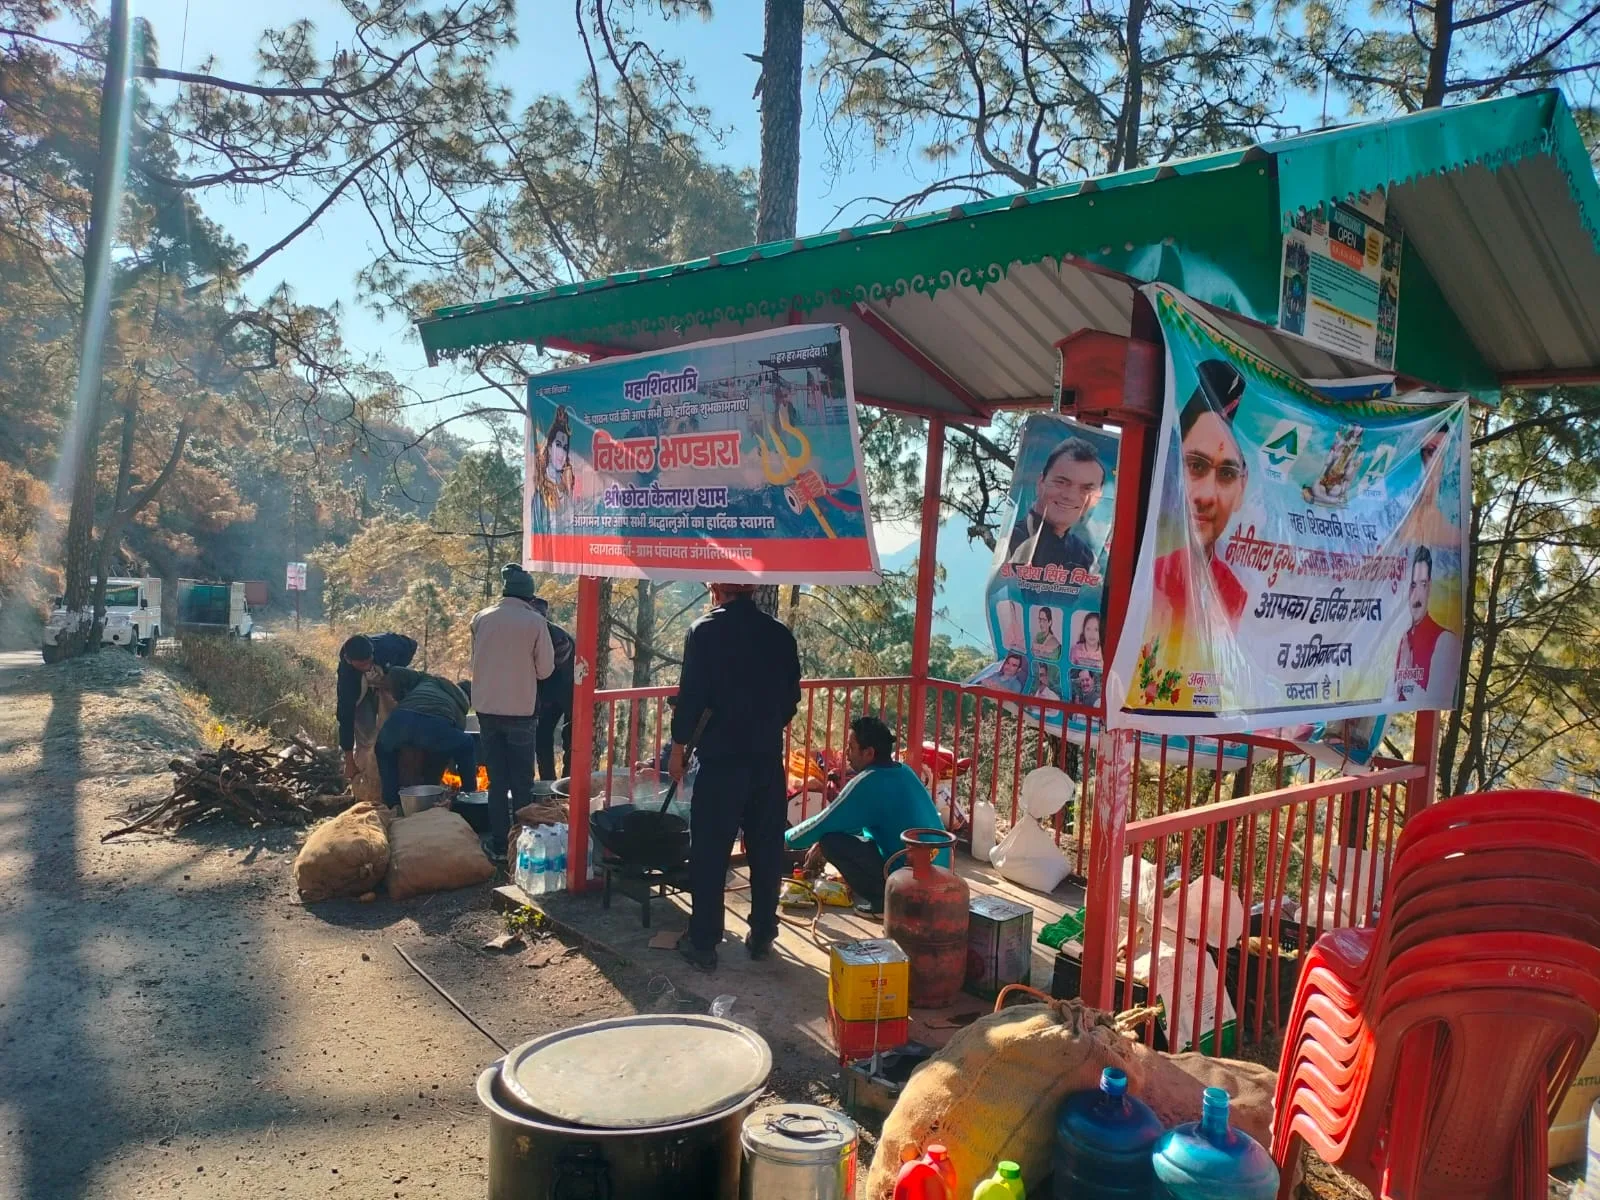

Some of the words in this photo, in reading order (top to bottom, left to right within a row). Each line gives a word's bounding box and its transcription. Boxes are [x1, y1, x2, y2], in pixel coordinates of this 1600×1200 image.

[1337, 226, 1357, 249] OPEN
[776, 352, 786, 364] हर
[786, 350, 795, 362] हर
[796, 345, 820, 360] महादेव
[624, 366, 699, 402] महाशिवरात्रि
[609, 409, 620, 422] पर्व
[620, 408, 630, 422] की
[631, 409, 646, 421] आप
[648, 405, 662, 419] सभी
[663, 404, 673, 418] को
[674, 401, 699, 418] हार्दिक
[593, 430, 656, 473] विशाल
[658, 431, 741, 472] भण्डारा
[604, 483, 620, 508] श्री
[621, 484, 650, 507] छोटा
[650, 482, 695, 508] कैलाश
[696, 486, 728, 508] धाम
[573, 515, 600, 528] आगमन
[601, 516, 612, 528] पर
[612, 515, 629, 528] आप
[630, 512, 647, 528] सभी
[648, 513, 689, 534] श्रद्धालुओं
[690, 516, 705, 529] का
[706, 512, 738, 531] हार्दिक
[739, 516, 776, 530] स्वागत
[1307, 509, 1343, 538] शिवरात्रि
[636, 544, 653, 557] ग्राम
[654, 541, 688, 558] पंचायत
[1225, 522, 1277, 572] नैनीताल
[1043, 562, 1069, 584] सिंह
[1254, 592, 1313, 621] आपका
[1309, 587, 1352, 625] हार्दिक
[1277, 643, 1291, 669] व
[1291, 633, 1352, 670] अभिनन्दन
[1285, 681, 1318, 700] करता
[1321, 674, 1332, 700] है
